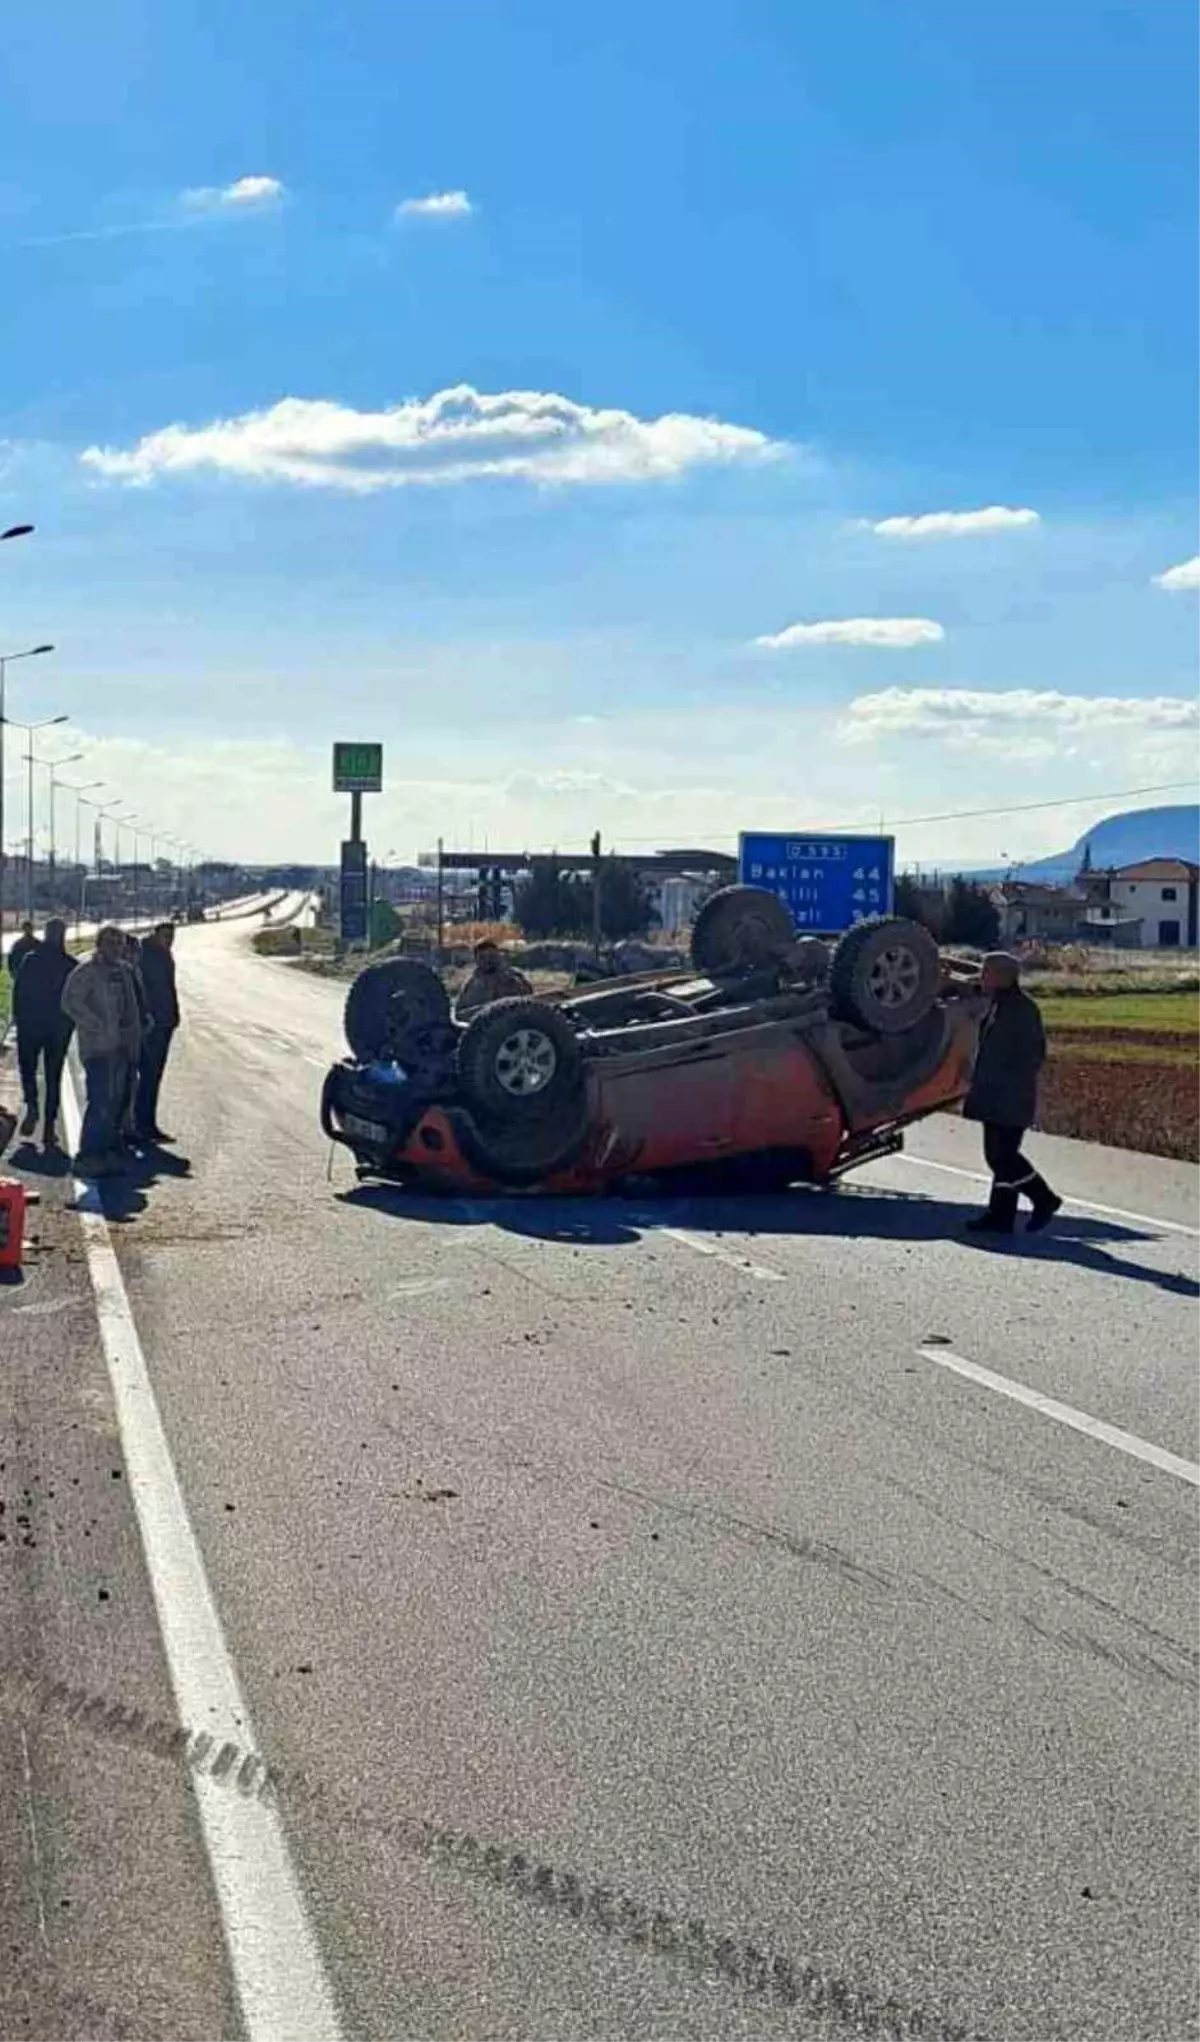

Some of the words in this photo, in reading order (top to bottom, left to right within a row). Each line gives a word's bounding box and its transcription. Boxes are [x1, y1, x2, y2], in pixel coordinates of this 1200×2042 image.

[751, 862, 824, 880] Baklan
[852, 866, 881, 880] 44
[852, 887, 880, 903] 45
